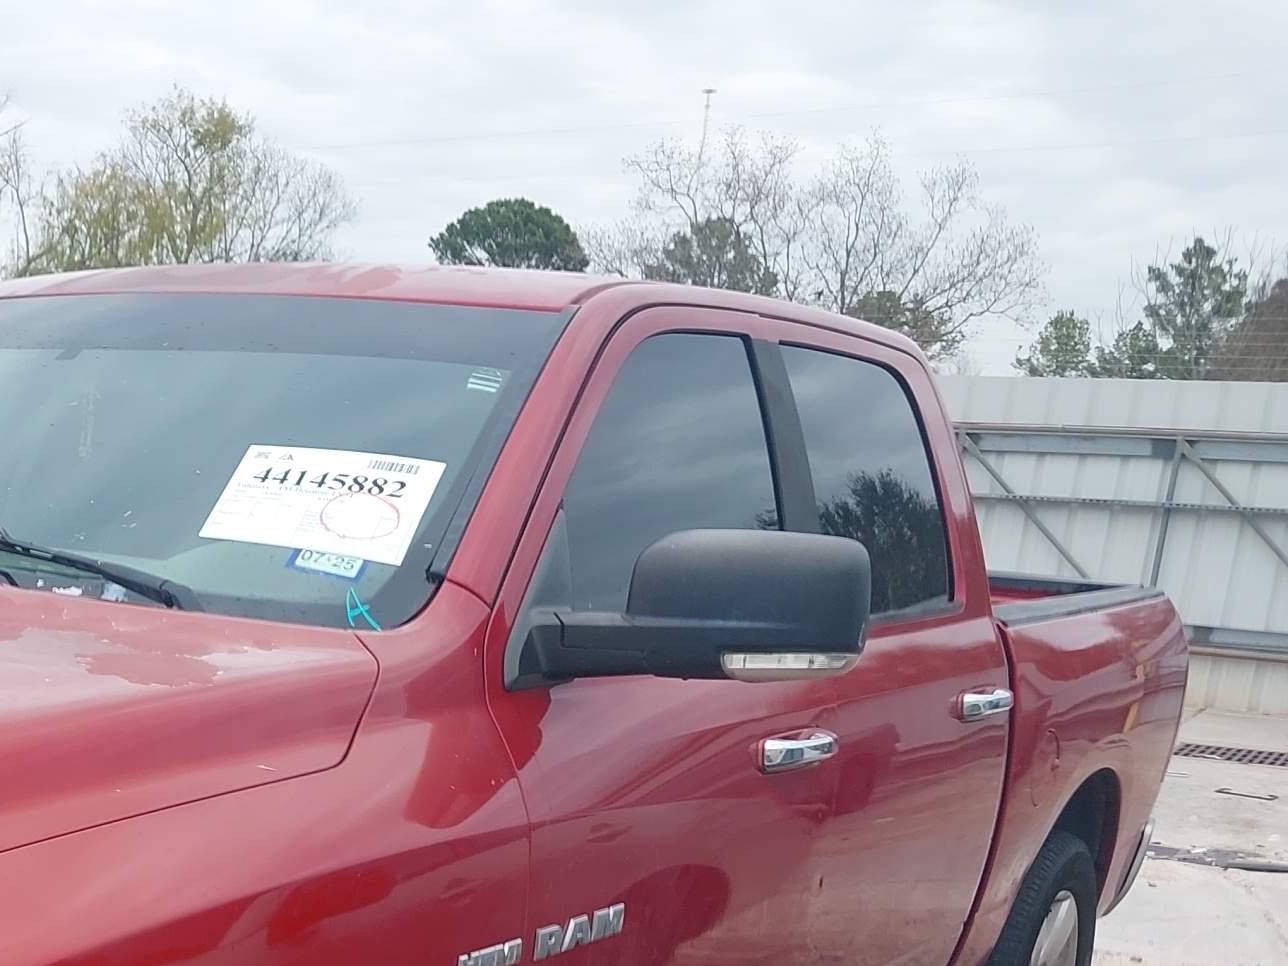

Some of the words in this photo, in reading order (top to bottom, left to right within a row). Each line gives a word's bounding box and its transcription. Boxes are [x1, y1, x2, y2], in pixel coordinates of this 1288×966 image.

[253, 467, 408, 499] 44145882
[345, 586, 382, 632] A
[533, 902, 625, 962] RAM
